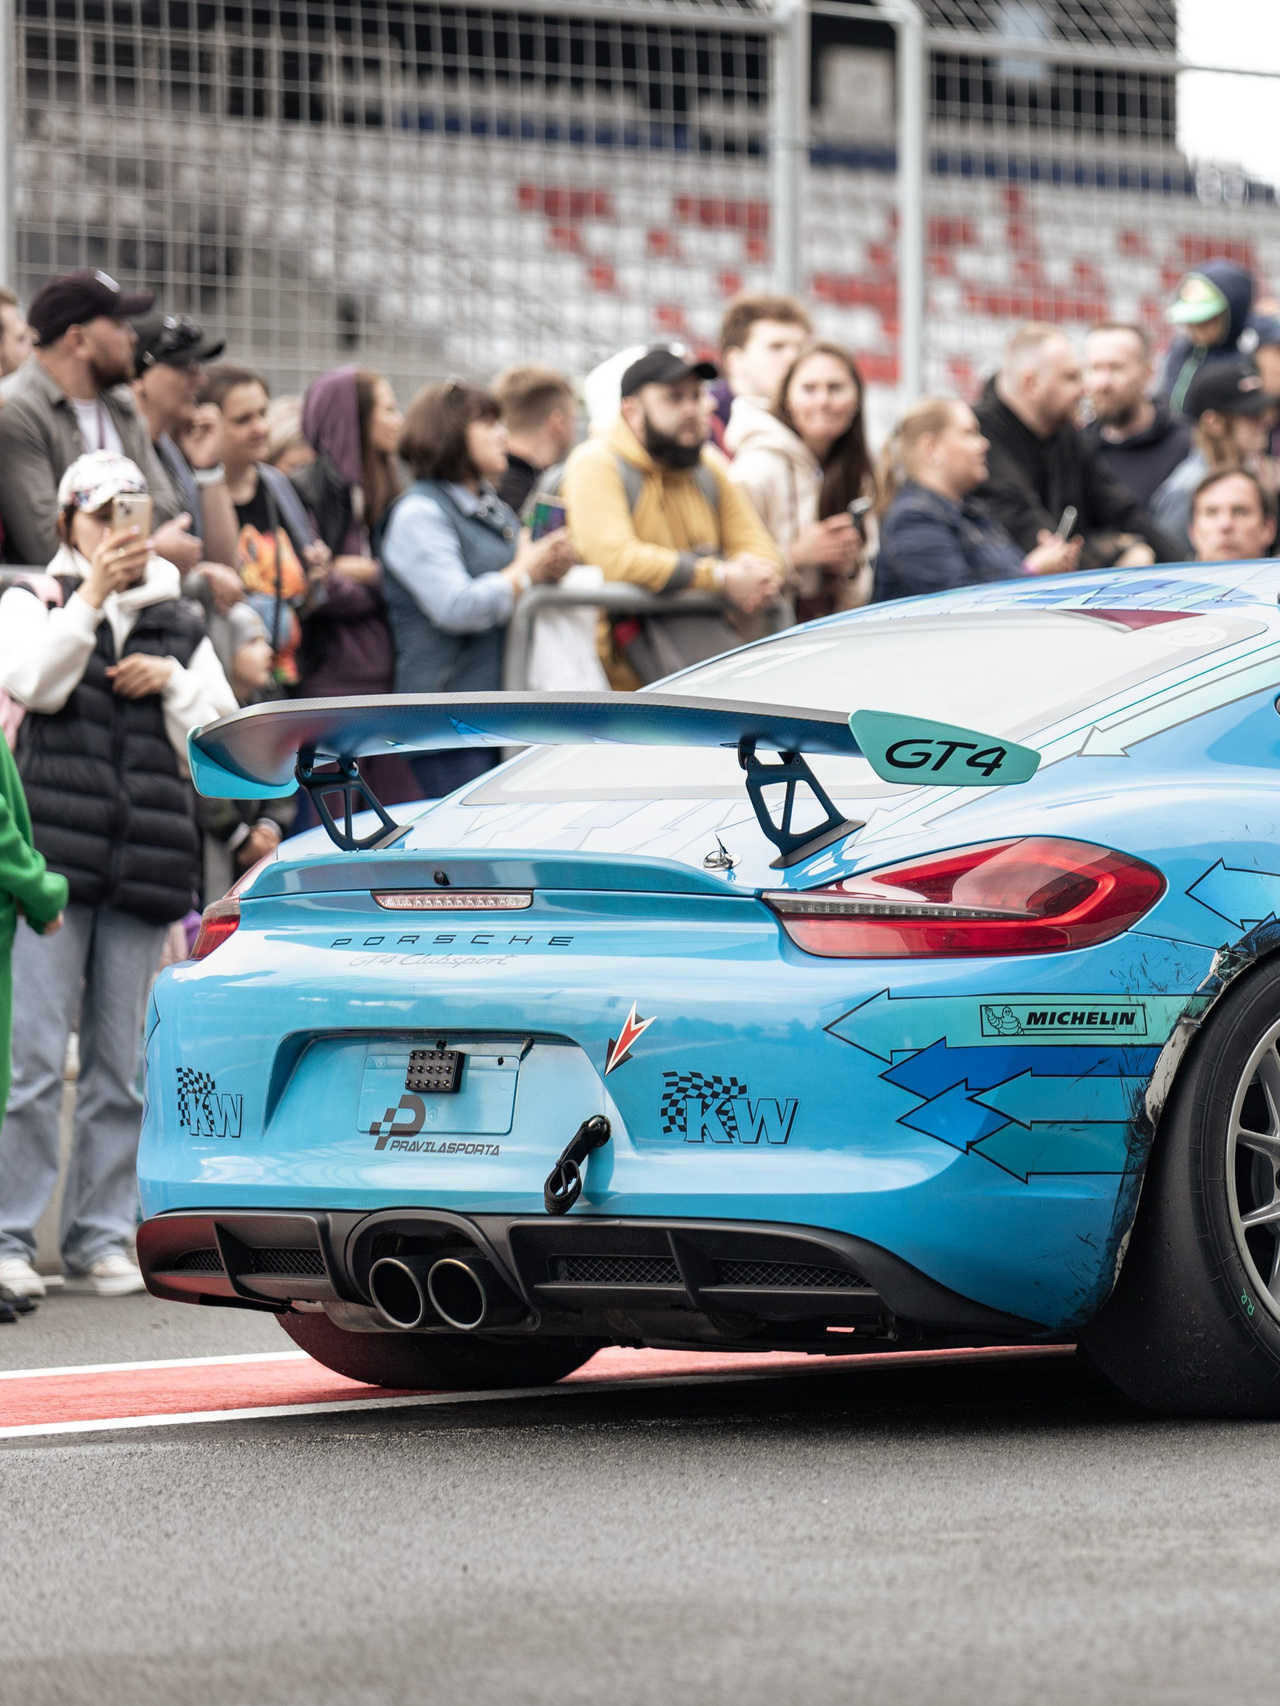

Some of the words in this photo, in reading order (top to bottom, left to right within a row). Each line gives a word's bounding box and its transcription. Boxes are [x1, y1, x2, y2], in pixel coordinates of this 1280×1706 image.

[885, 738, 1008, 777] GT4
[330, 934, 574, 948] PORSCHE
[349, 954, 398, 967] GT4
[399, 953, 518, 968] Clubsport
[1026, 1010, 1136, 1026] MICHELIN
[188, 1093, 243, 1138] KW
[685, 1098, 799, 1144] KW
[390, 1139, 500, 1156] PRAVILASPORTA
